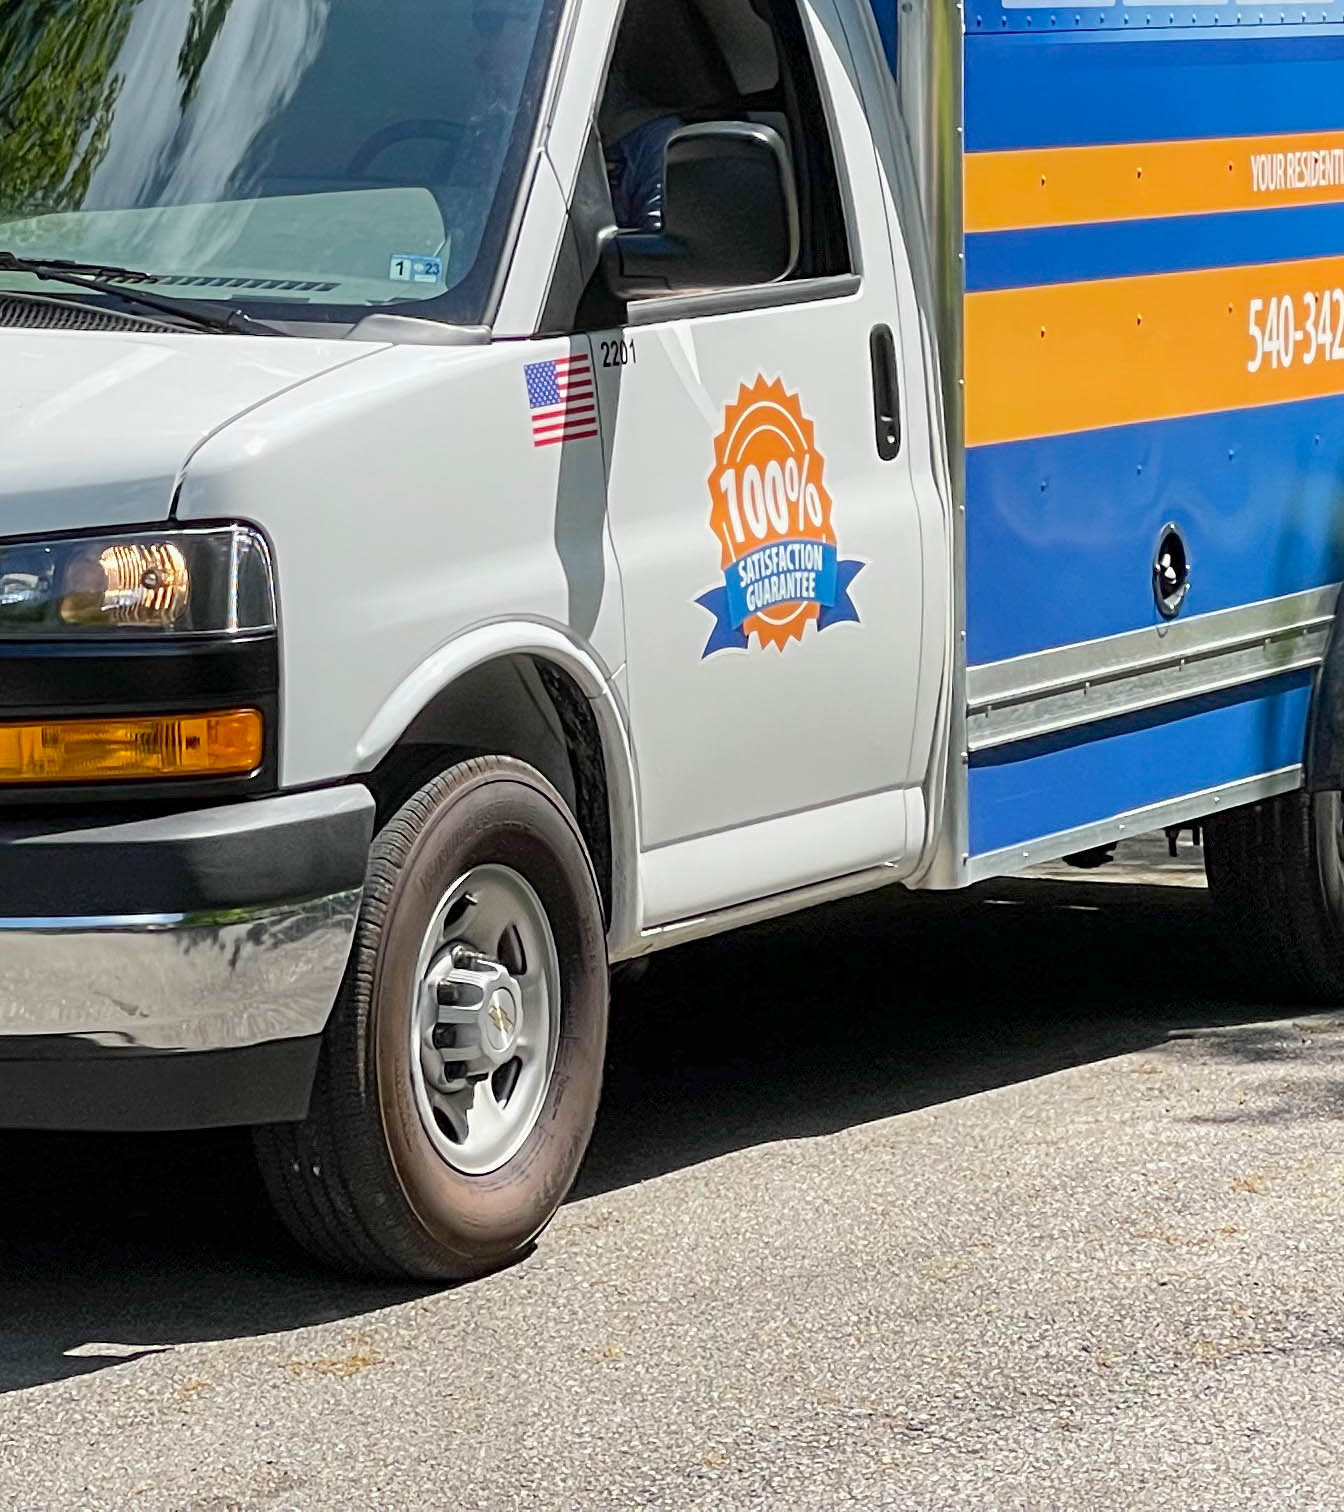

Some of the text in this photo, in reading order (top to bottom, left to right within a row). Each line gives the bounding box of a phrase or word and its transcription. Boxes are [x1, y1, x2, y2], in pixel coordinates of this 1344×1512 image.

[1250, 152, 1285, 192] YOUR
[395, 260, 440, 276] 1 23
[600, 339, 637, 368] 2201
[719, 453, 822, 544] 100%
[737, 543, 823, 588] SATISFACTION
[746, 574, 817, 612] GUARANTEE
